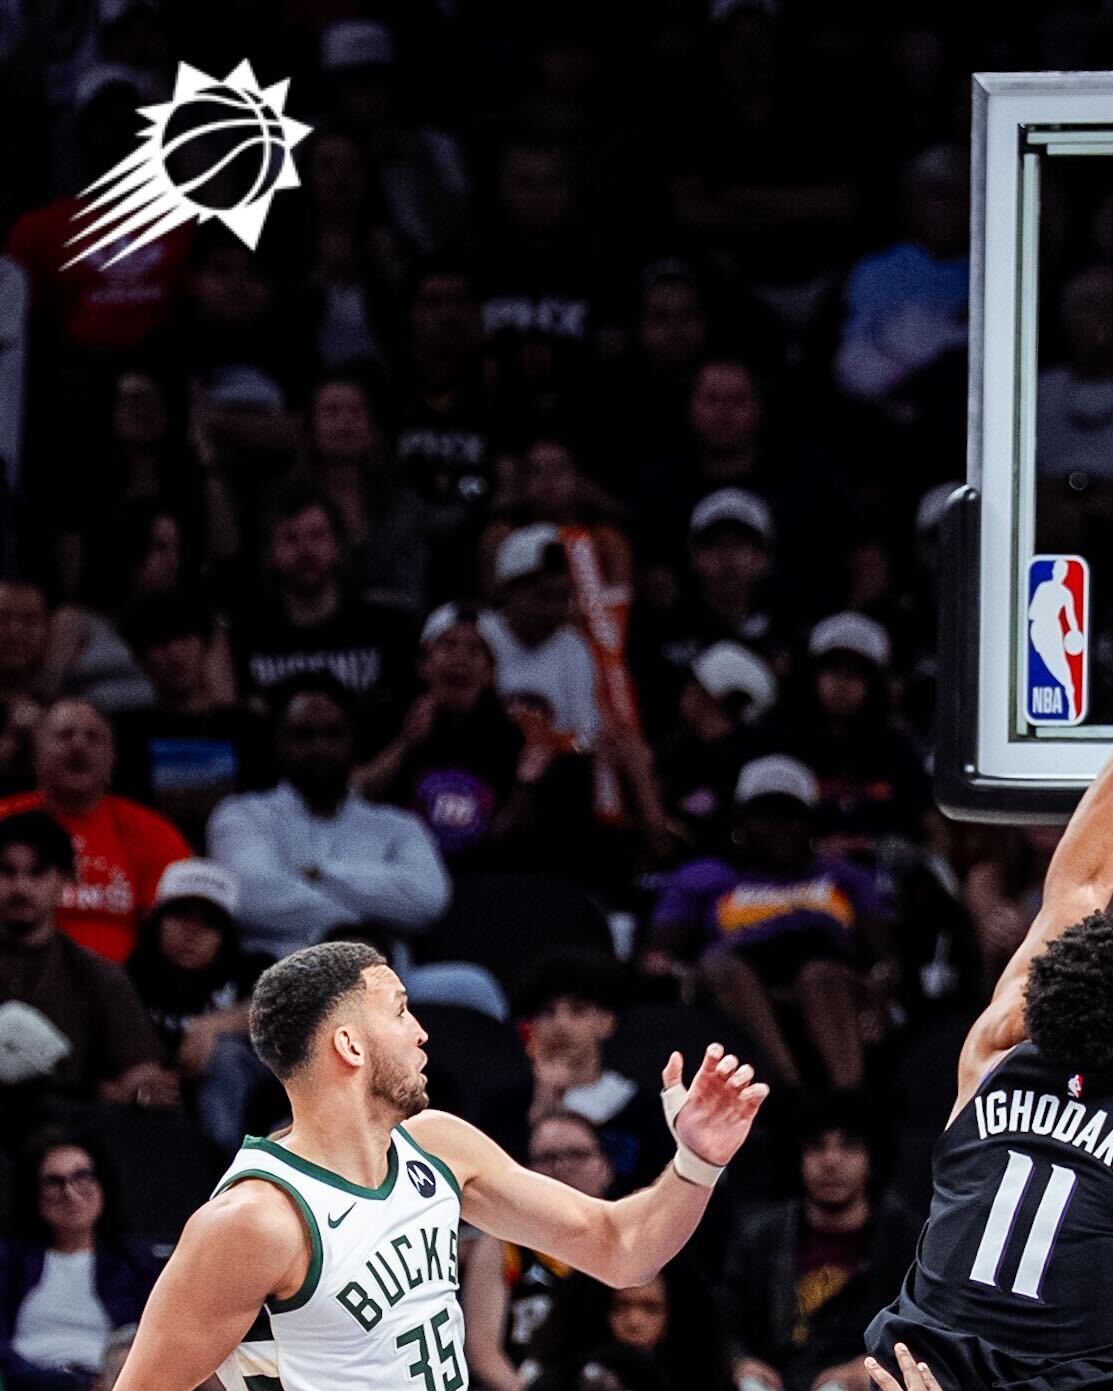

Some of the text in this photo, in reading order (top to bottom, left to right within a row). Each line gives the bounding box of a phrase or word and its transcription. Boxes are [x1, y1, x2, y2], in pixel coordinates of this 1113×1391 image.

[1032, 686, 1062, 714] NBA
[969, 1150, 1078, 1301] 11
[335, 1226, 458, 1333] BUCKS
